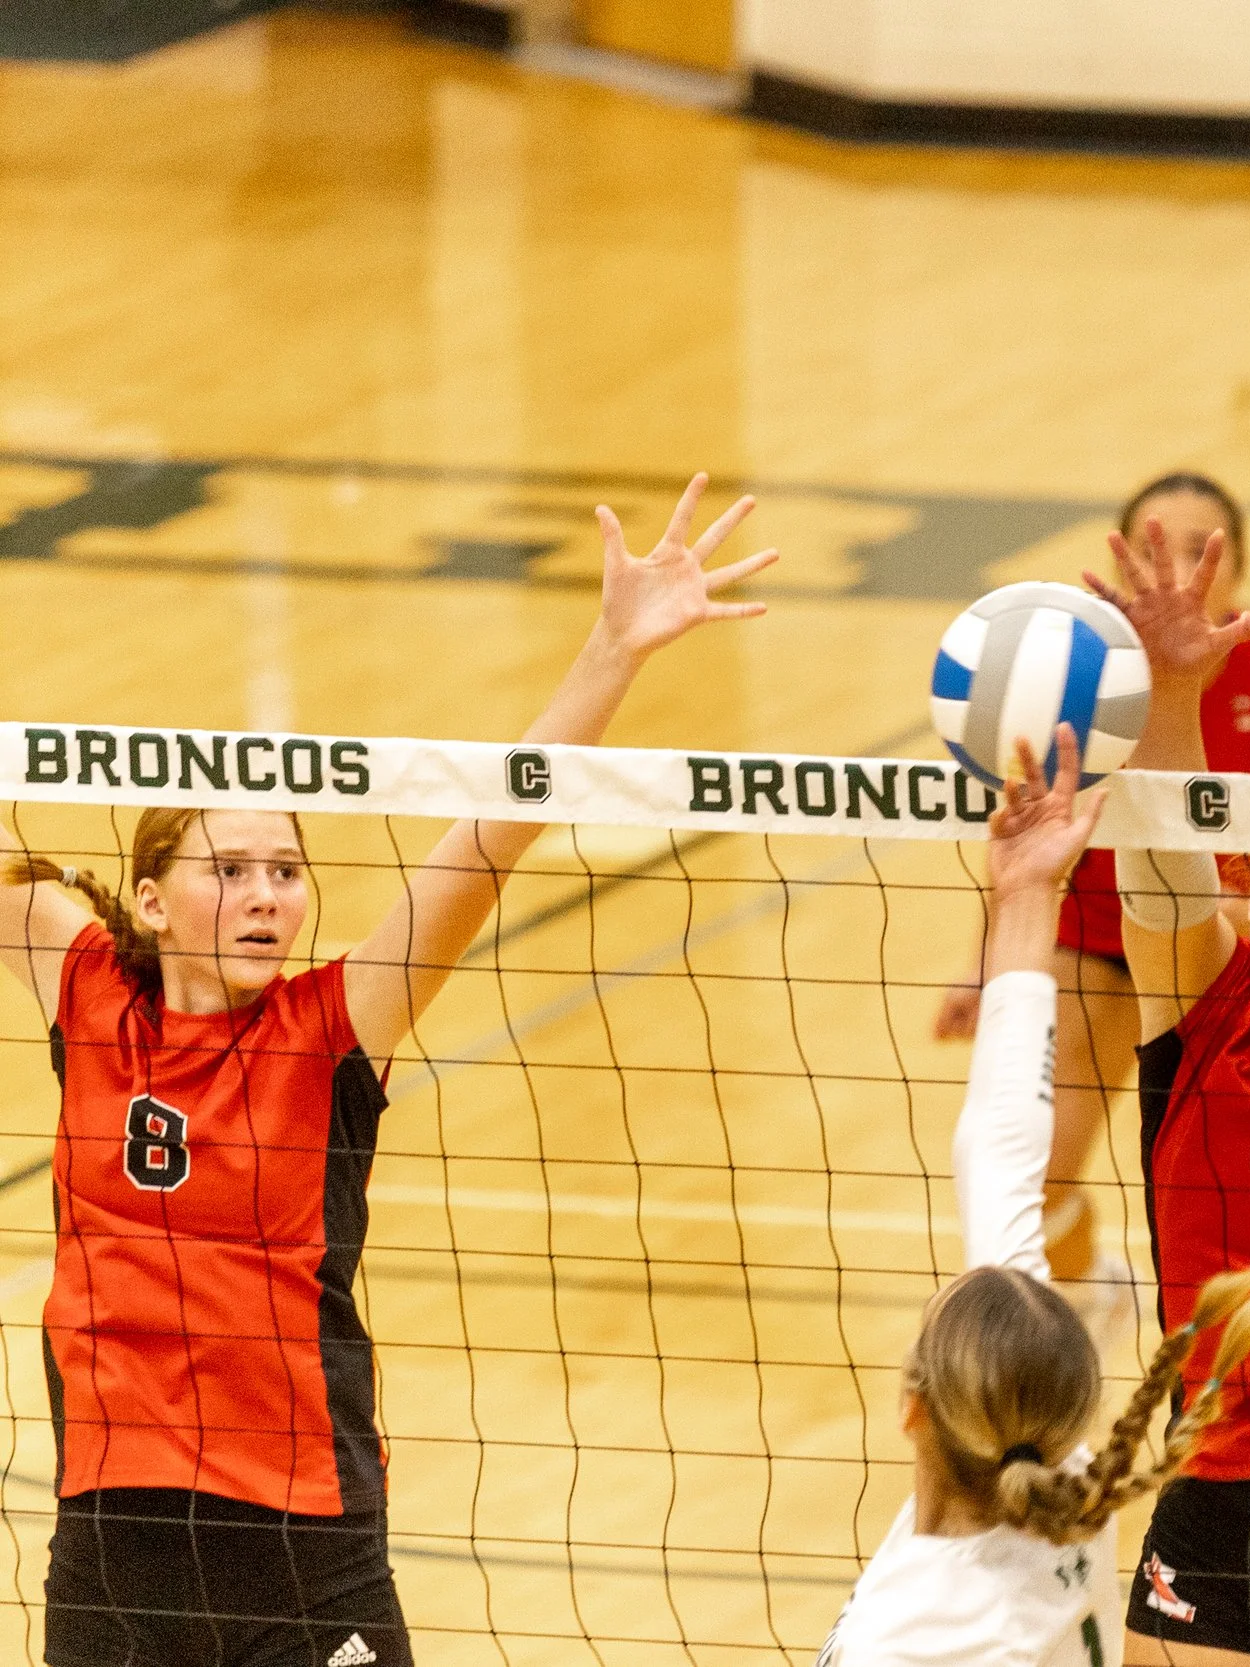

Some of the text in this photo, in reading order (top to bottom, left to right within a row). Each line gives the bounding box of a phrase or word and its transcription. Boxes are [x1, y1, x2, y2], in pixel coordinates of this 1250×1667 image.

[24, 728, 370, 796] BRONCOS
[505, 748, 552, 804] C
[687, 757, 997, 823] BRONCO
[1184, 776, 1231, 832] C
[124, 1094, 190, 1192] 8
